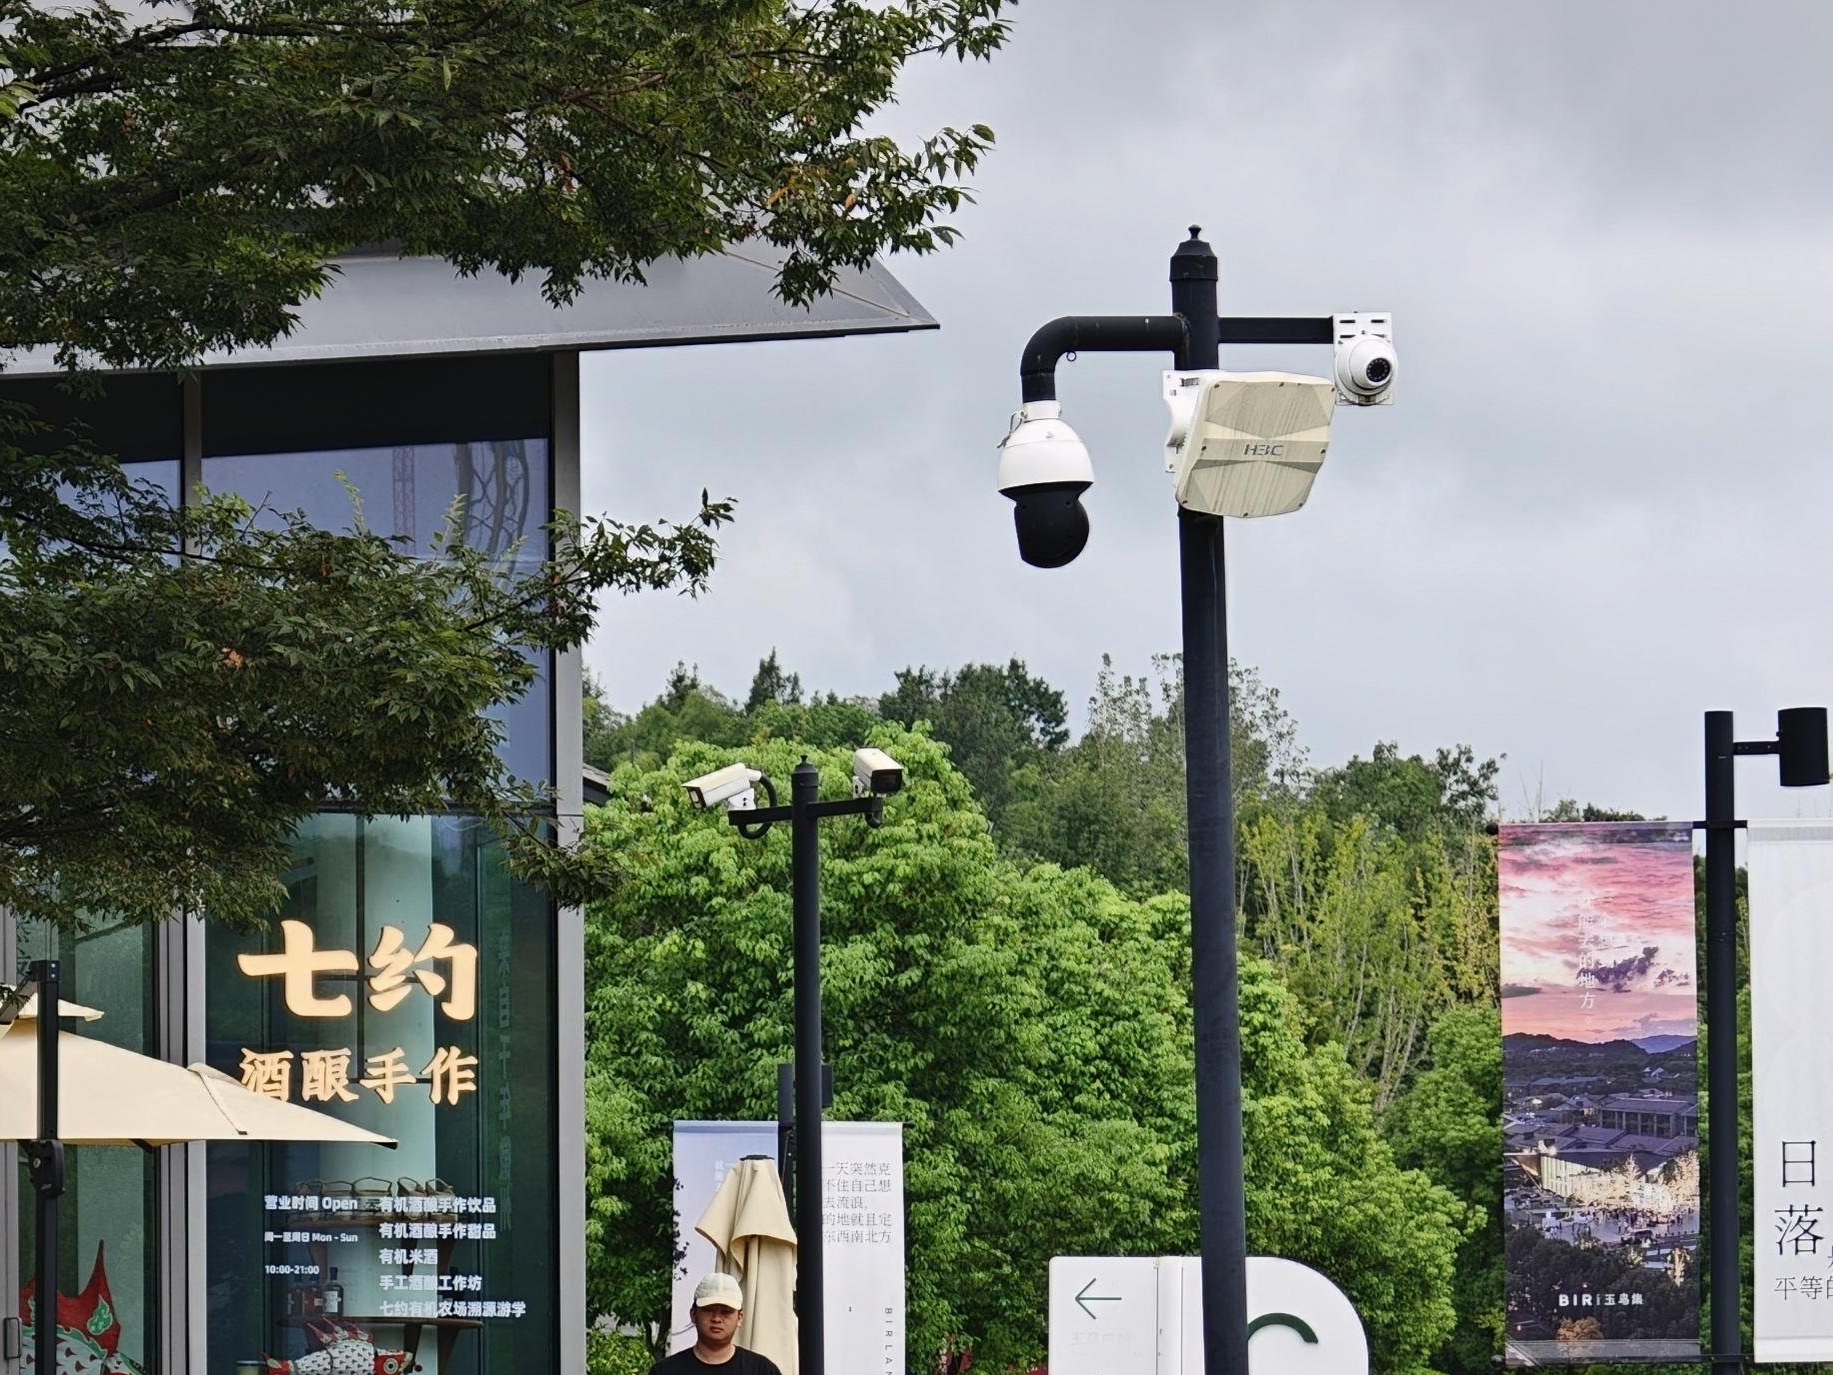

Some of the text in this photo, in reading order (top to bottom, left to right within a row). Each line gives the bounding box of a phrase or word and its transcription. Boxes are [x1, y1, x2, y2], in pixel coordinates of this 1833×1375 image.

[237, 919, 479, 1021] 七约
[238, 1045, 479, 1106] 酒酿手作
[264, 1195, 358, 1212] 营业时间 Open
[378, 1197, 496, 1213] 有机酒酿手作饮品
[264, 1232, 310, 1243] 周一至周日
[312, 1233, 332, 1243] Mon
[340, 1233, 358, 1243] Sun
[378, 1223, 497, 1239] 有机酒酿手作甜品
[378, 1248, 438, 1265] 有机米酒
[265, 1265, 319, 1275] 10:00-21:00
[378, 1275, 482, 1291] 手工酒酿工作坊
